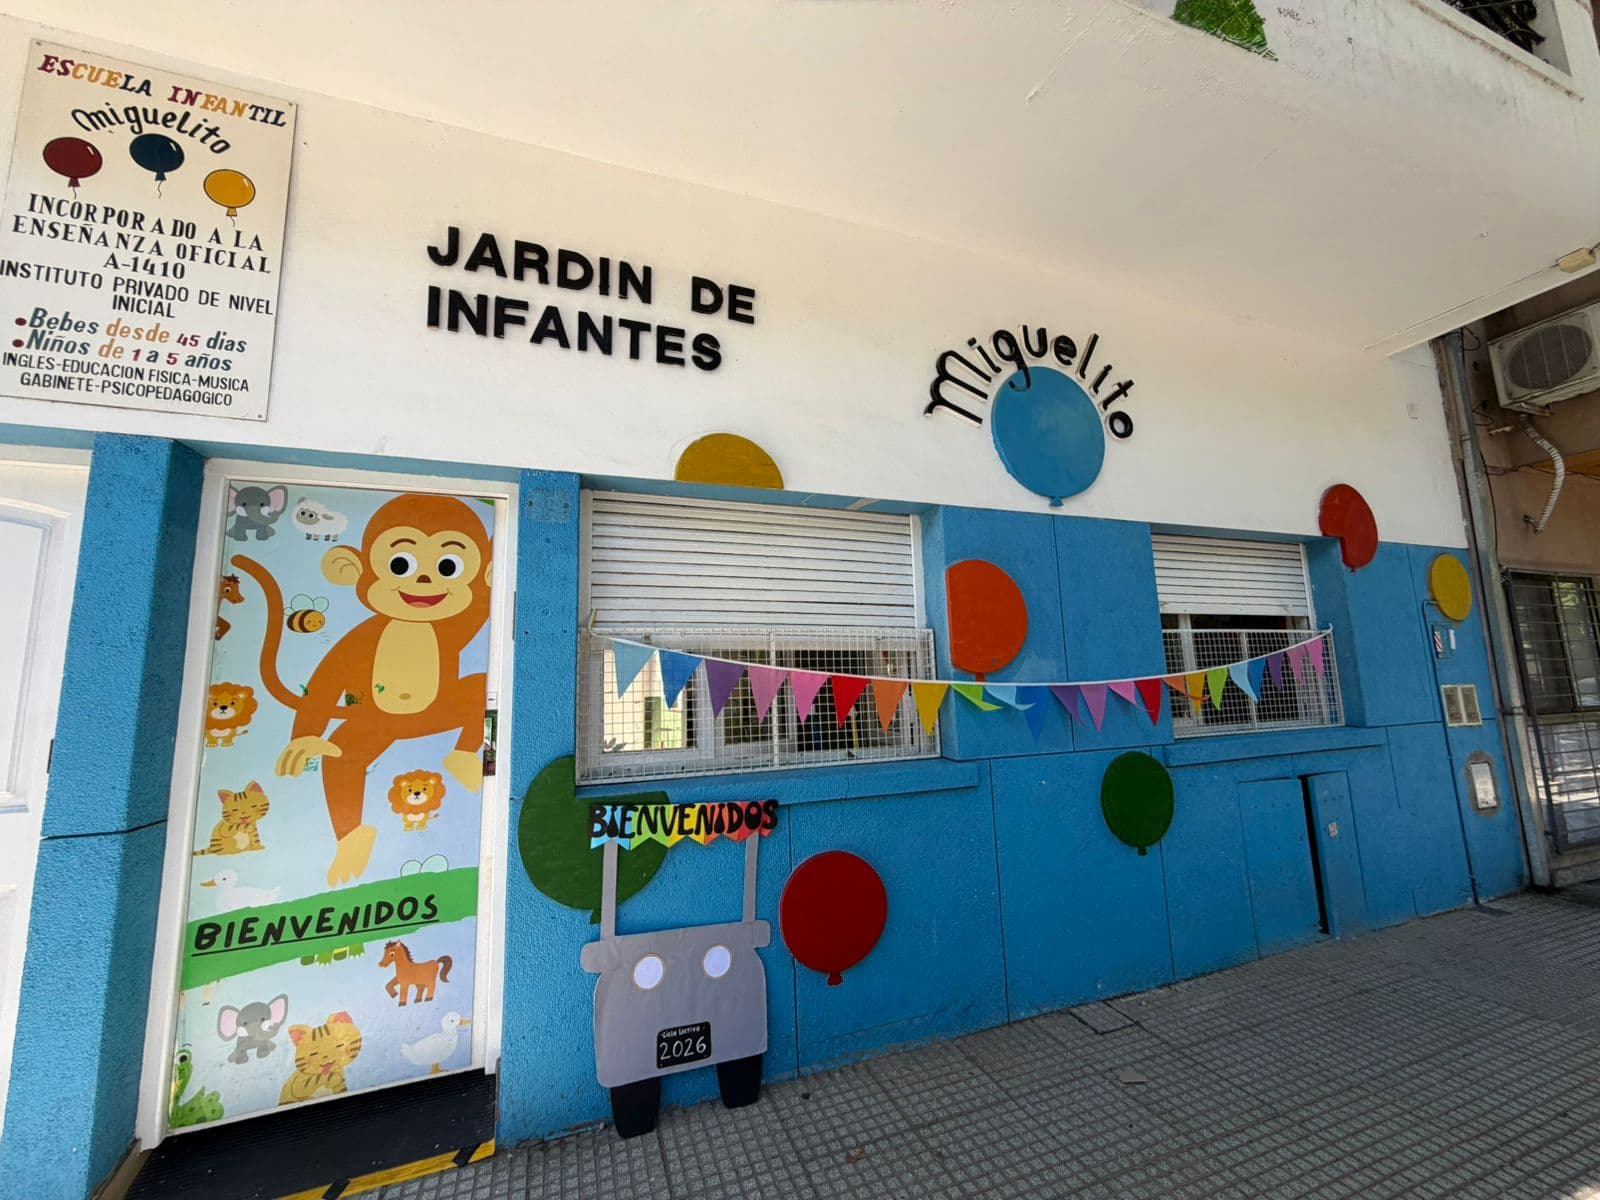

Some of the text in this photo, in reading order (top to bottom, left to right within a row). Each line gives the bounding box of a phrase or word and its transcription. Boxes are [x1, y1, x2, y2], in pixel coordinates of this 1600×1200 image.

[37, 54, 287, 127] ESCUELA INFANTIL
[12, 214, 271, 274] ENSEÑANZA OFICIAL
[28, 193, 264, 251] INCORPORADO A LA
[0, 259, 274, 315] INSTITUTO PRIVADO DE NIVEL
[102, 252, 186, 280] A-1410
[426, 226, 756, 325] JARDIN DE
[29, 306, 248, 353] Bebes desde 45 dias
[112, 294, 176, 318] INICIAL
[427, 285, 723, 372] INFANTES
[2, 351, 250, 393] INGLES-EDUCACION FISICA-MUSICA
[25, 328, 233, 371] Niños de 1 a 5 años
[590, 799, 779, 839] BIENVENIDOS
[194, 894, 439, 950] BIENVENIDOS
[659, 1036, 706, 1060] 2026
